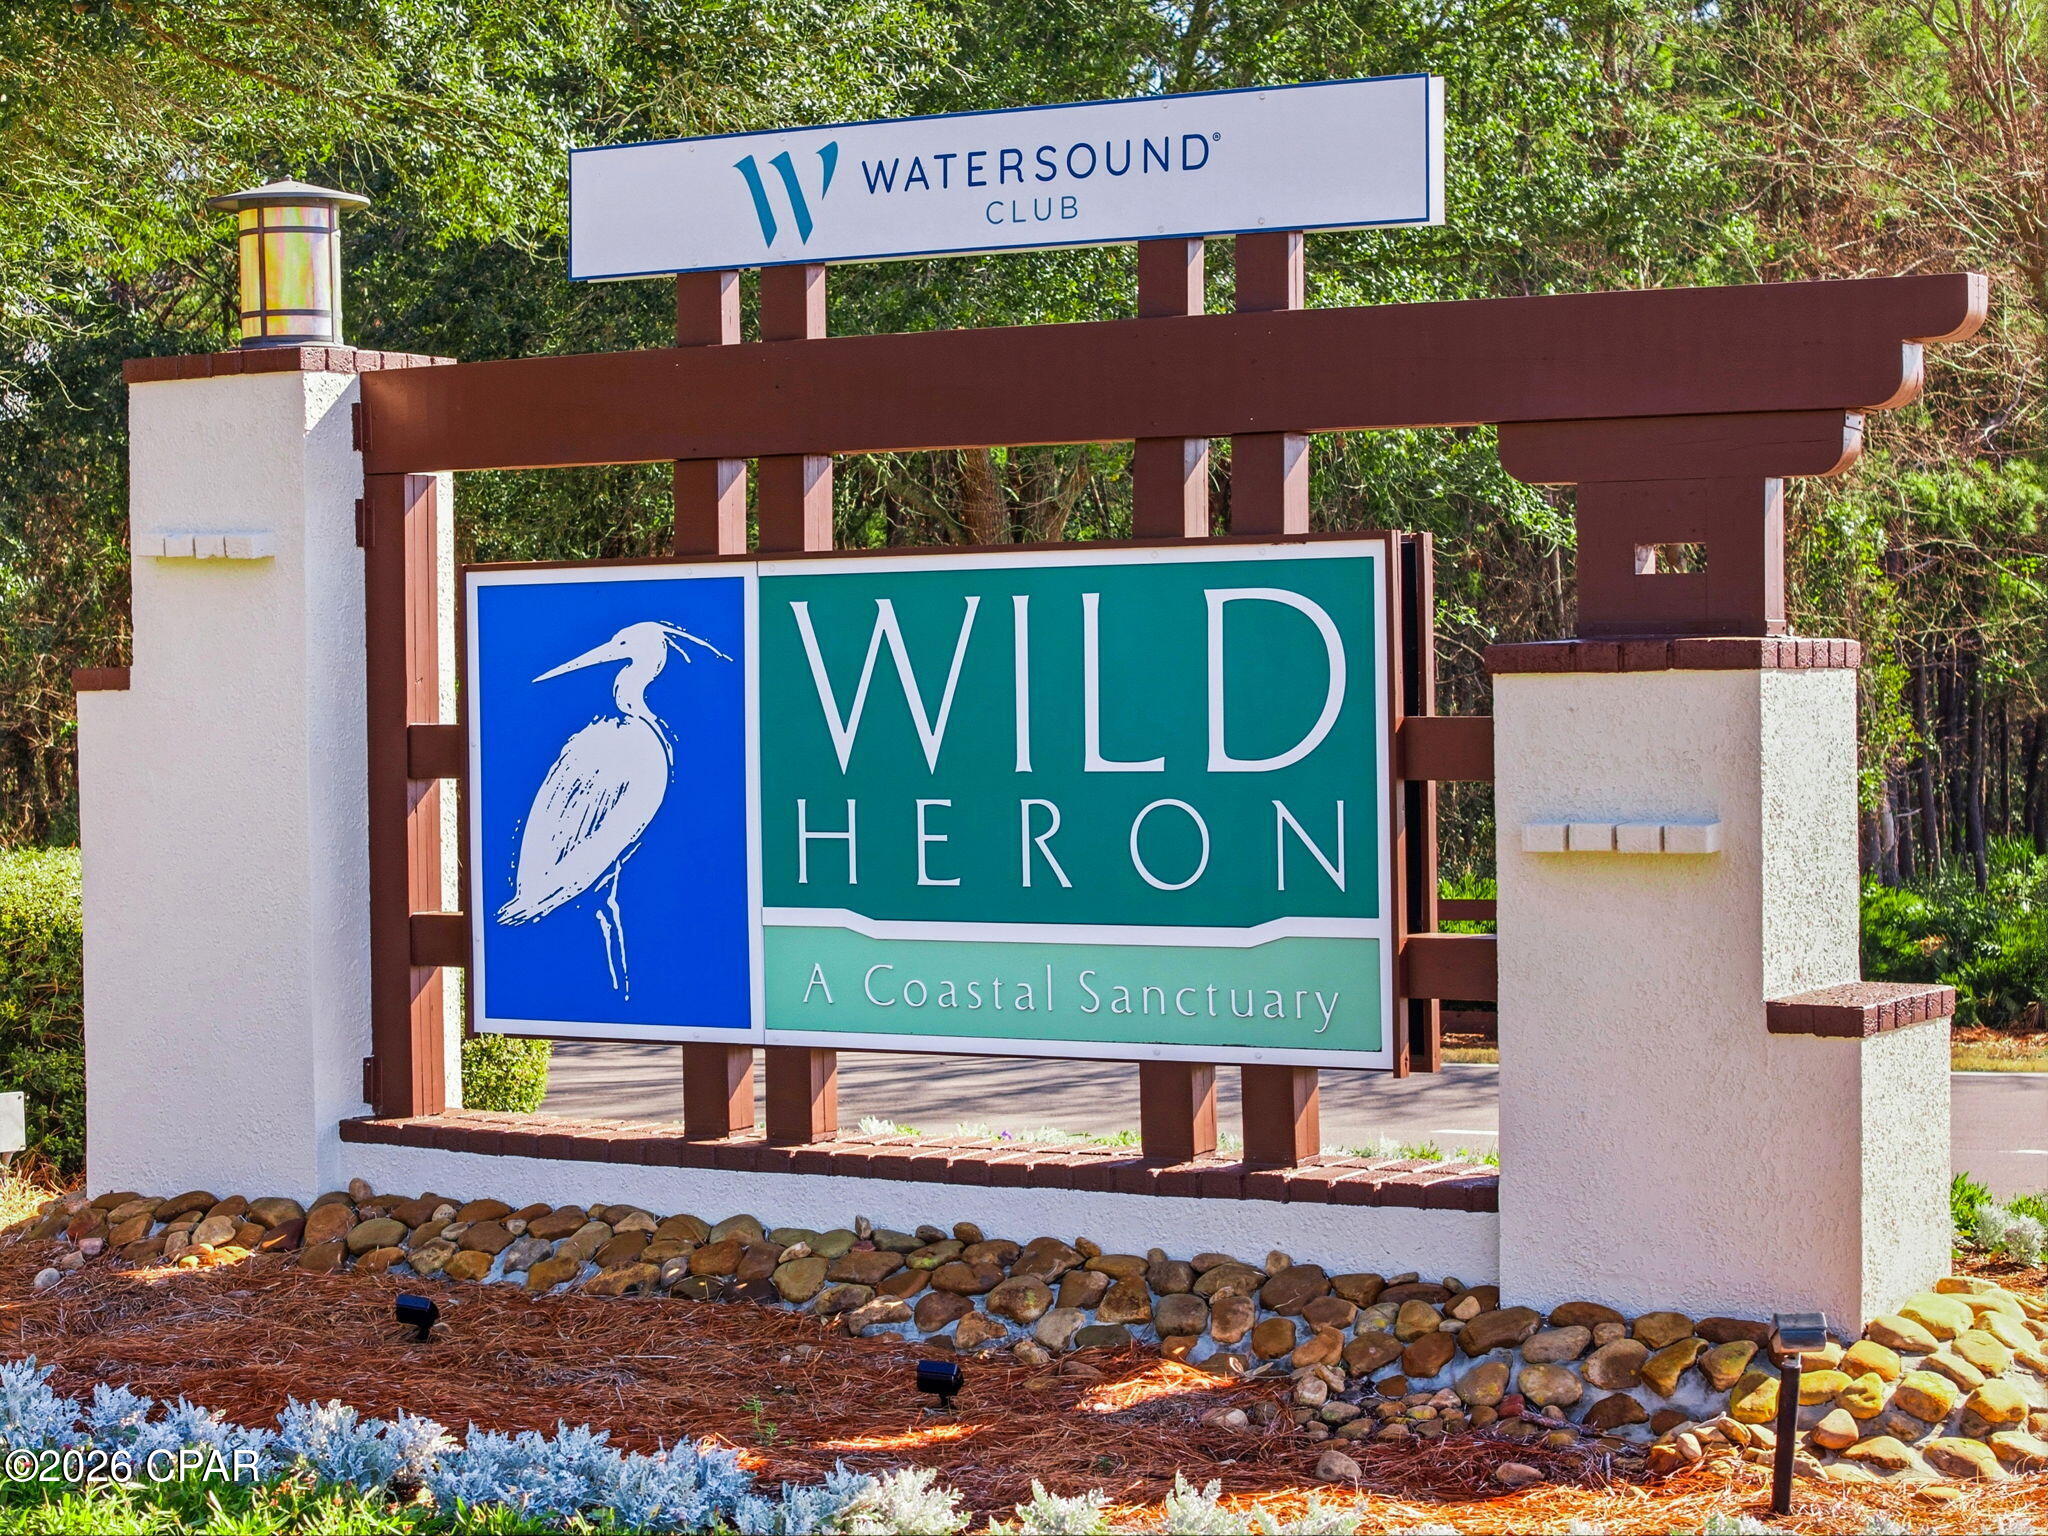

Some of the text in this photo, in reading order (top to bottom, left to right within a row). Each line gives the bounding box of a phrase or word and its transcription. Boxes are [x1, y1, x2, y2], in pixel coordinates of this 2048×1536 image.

[986, 195, 1079, 225] CLUB
[789, 586, 1347, 775] WILD
[796, 797, 1347, 894] HERON
[803, 962, 1341, 1034] A Coastal Sanctuary
